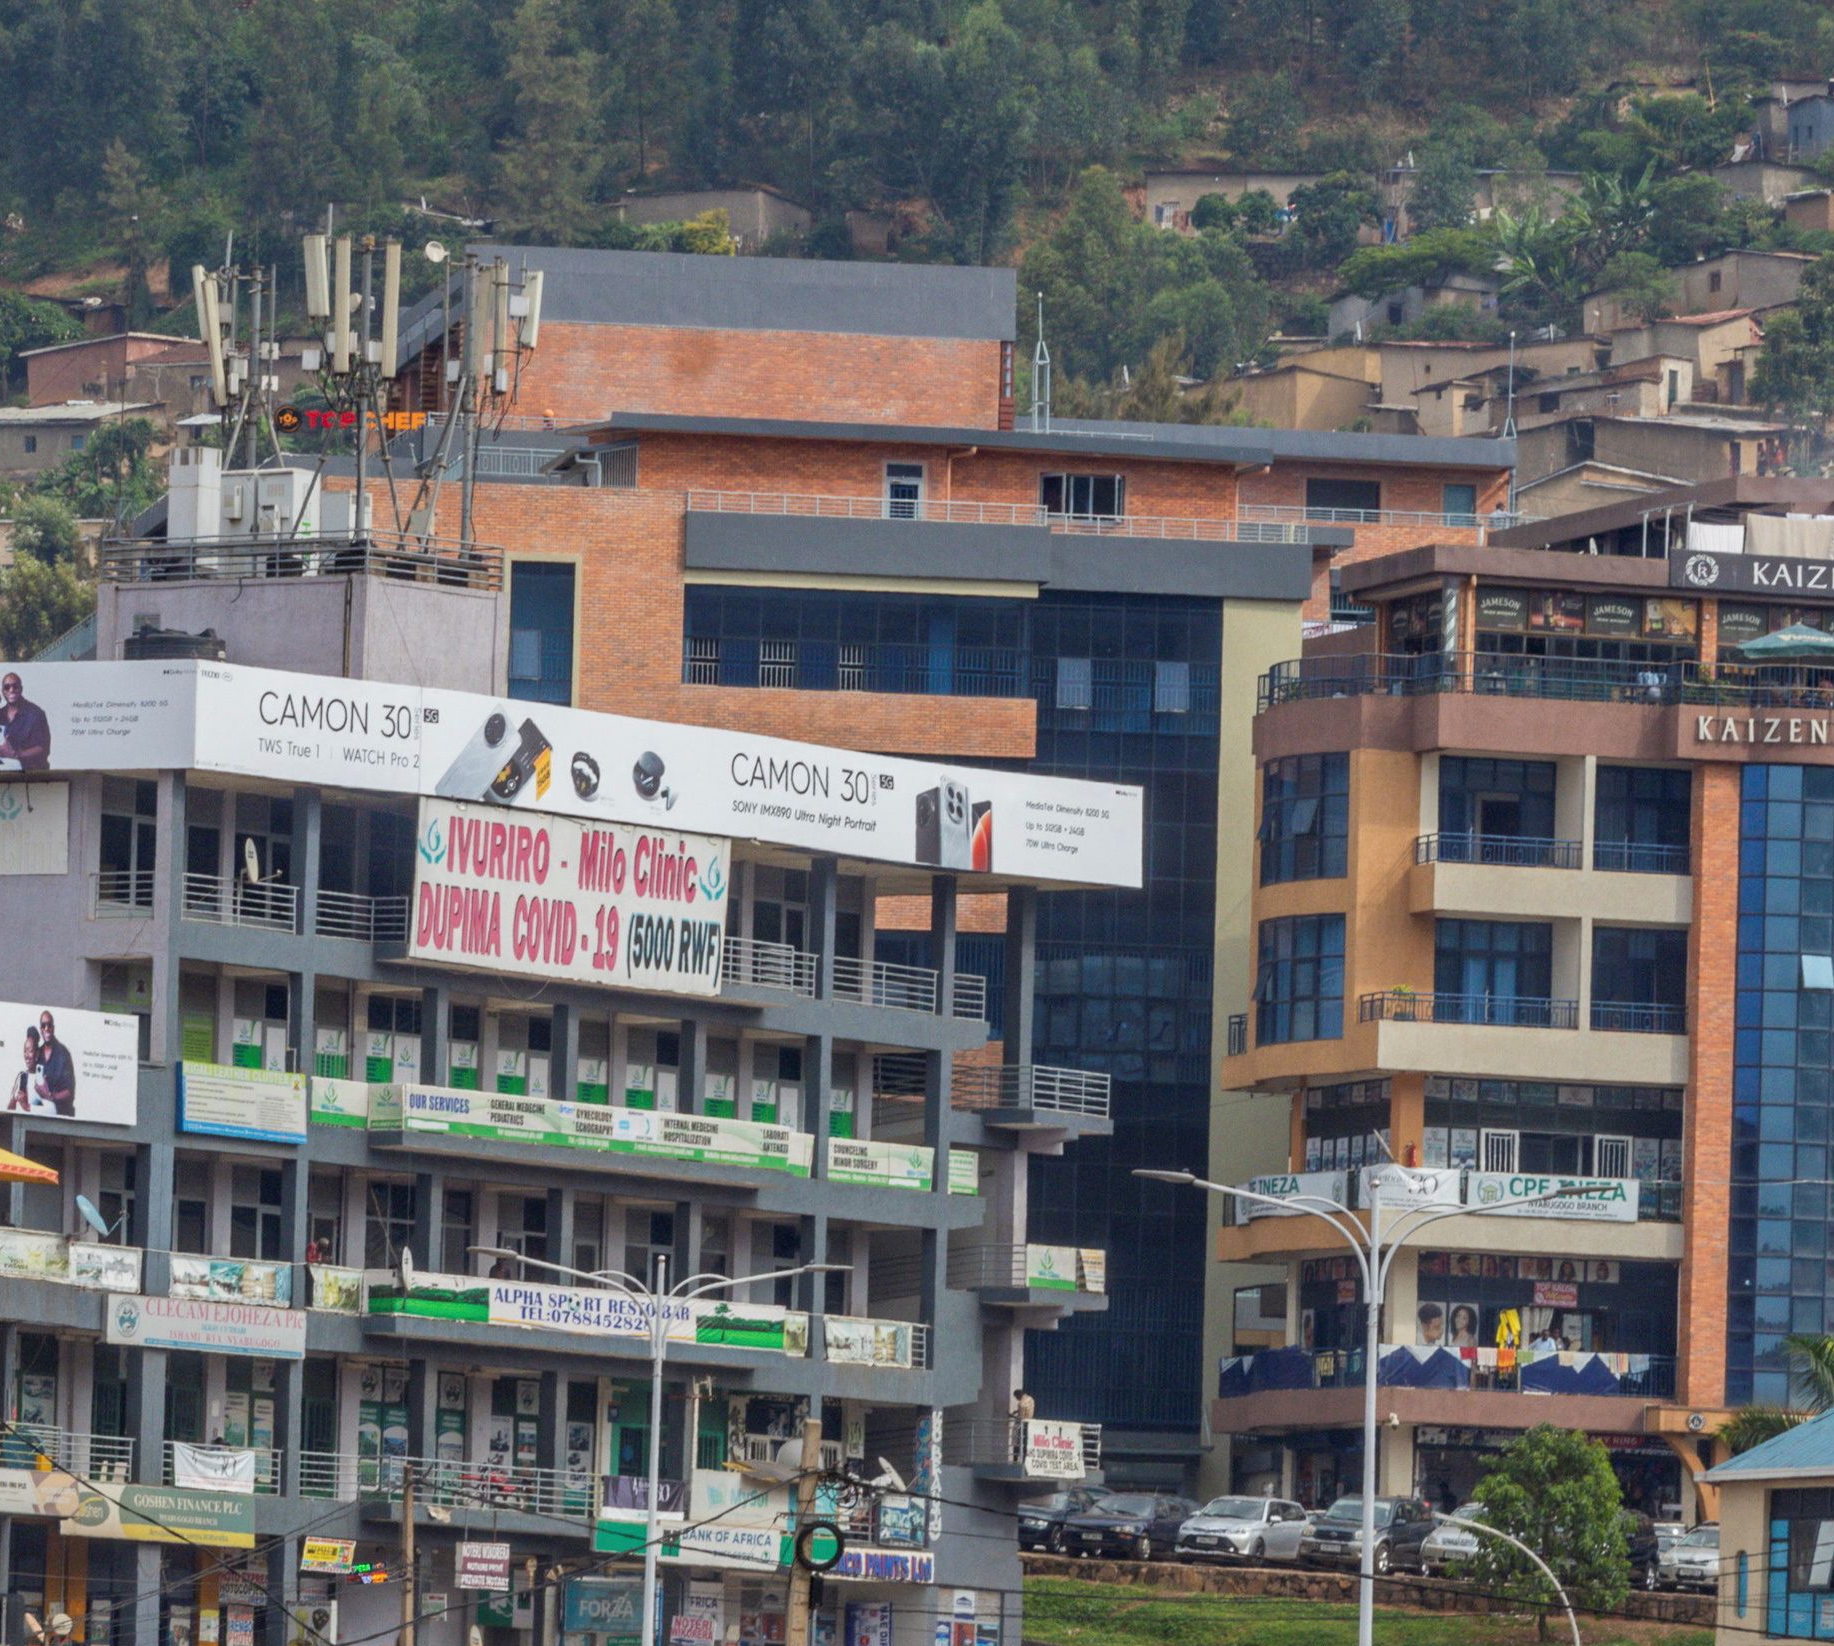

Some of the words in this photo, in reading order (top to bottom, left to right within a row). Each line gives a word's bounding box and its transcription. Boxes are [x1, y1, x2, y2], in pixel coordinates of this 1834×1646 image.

[1481, 597, 1521, 611] JAMESON
[1594, 603, 1634, 618] JAMESON
[1721, 612, 1761, 627] JAMESON
[259, 691, 368, 736] CAMON
[380, 704, 413, 739] 30
[424, 708, 439, 724] 5G
[1698, 715, 1828, 745] KAIZEN
[258, 738, 283, 753] TWS
[286, 742, 312, 758] True
[343, 749, 386, 766] WATCH
[390, 753, 409, 769] Pro
[413, 754, 420, 769] 2
[731, 752, 829, 798] CAMON
[841, 769, 869, 804] 30
[879, 774, 894, 790] 5G
[732, 800, 757, 815] SONY
[760, 804, 792, 819] IMX890
[794, 807, 815, 823] Ultra
[818, 812, 842, 832] Night
[844, 815, 877, 832] Portrait
[1026, 801, 1053, 811] MediaTek
[1055, 803, 1083, 817] Dimensity
[1057, 843, 1079, 855] Charge
[447, 815, 551, 886] IVURIRO
[578, 830, 627, 895] Milo
[633, 834, 698, 904] Clinic
[416, 881, 501, 958] DUPIMA
[512, 894, 578, 966] COVID
[593, 904, 620, 972] 19
[627, 912, 674, 980] (5000
[678, 917, 721, 989] RWF)
[409, 1093, 427, 1110] OUR
[429, 1095, 470, 1114] SERVICES
[490, 1098, 516, 1111] GENERAL
[490, 1113, 524, 1126] PEDIATRICS
[576, 1108, 613, 1122] GYNECOLOGY
[575, 1124, 614, 1137] ECHOGRAPHY
[664, 1118, 690, 1131] INTERNAL
[663, 1130, 712, 1146] HOSPITALIZATION
[853, 1158, 879, 1170] SURGERY
[1259, 1175, 1301, 1195] INEZA
[1528, 1200, 1575, 1212] NYABUGOGO
[1577, 1202, 1608, 1213] BRANCH
[146, 1296, 210, 1320] CLECAM
[215, 1306, 282, 1328] EJOHEZA
[494, 1286, 543, 1306] ALPHA
[661, 1303, 691, 1321] BAR
[1051, 1434, 1075, 1451] Clinic
[134, 1493, 176, 1510] GOSHEN
[176, 1497, 222, 1514] FINANCE
[223, 1501, 243, 1516] PLC
[682, 1529, 713, 1543] BANK
[715, 1531, 730, 1544] OF
[732, 1532, 773, 1547] AFRICA
[865, 1553, 909, 1579] PAINTS
[912, 1556, 932, 1583] Ltd
[578, 1591, 634, 1623] FORZZA
[675, 1616, 713, 1630] NOTERI
